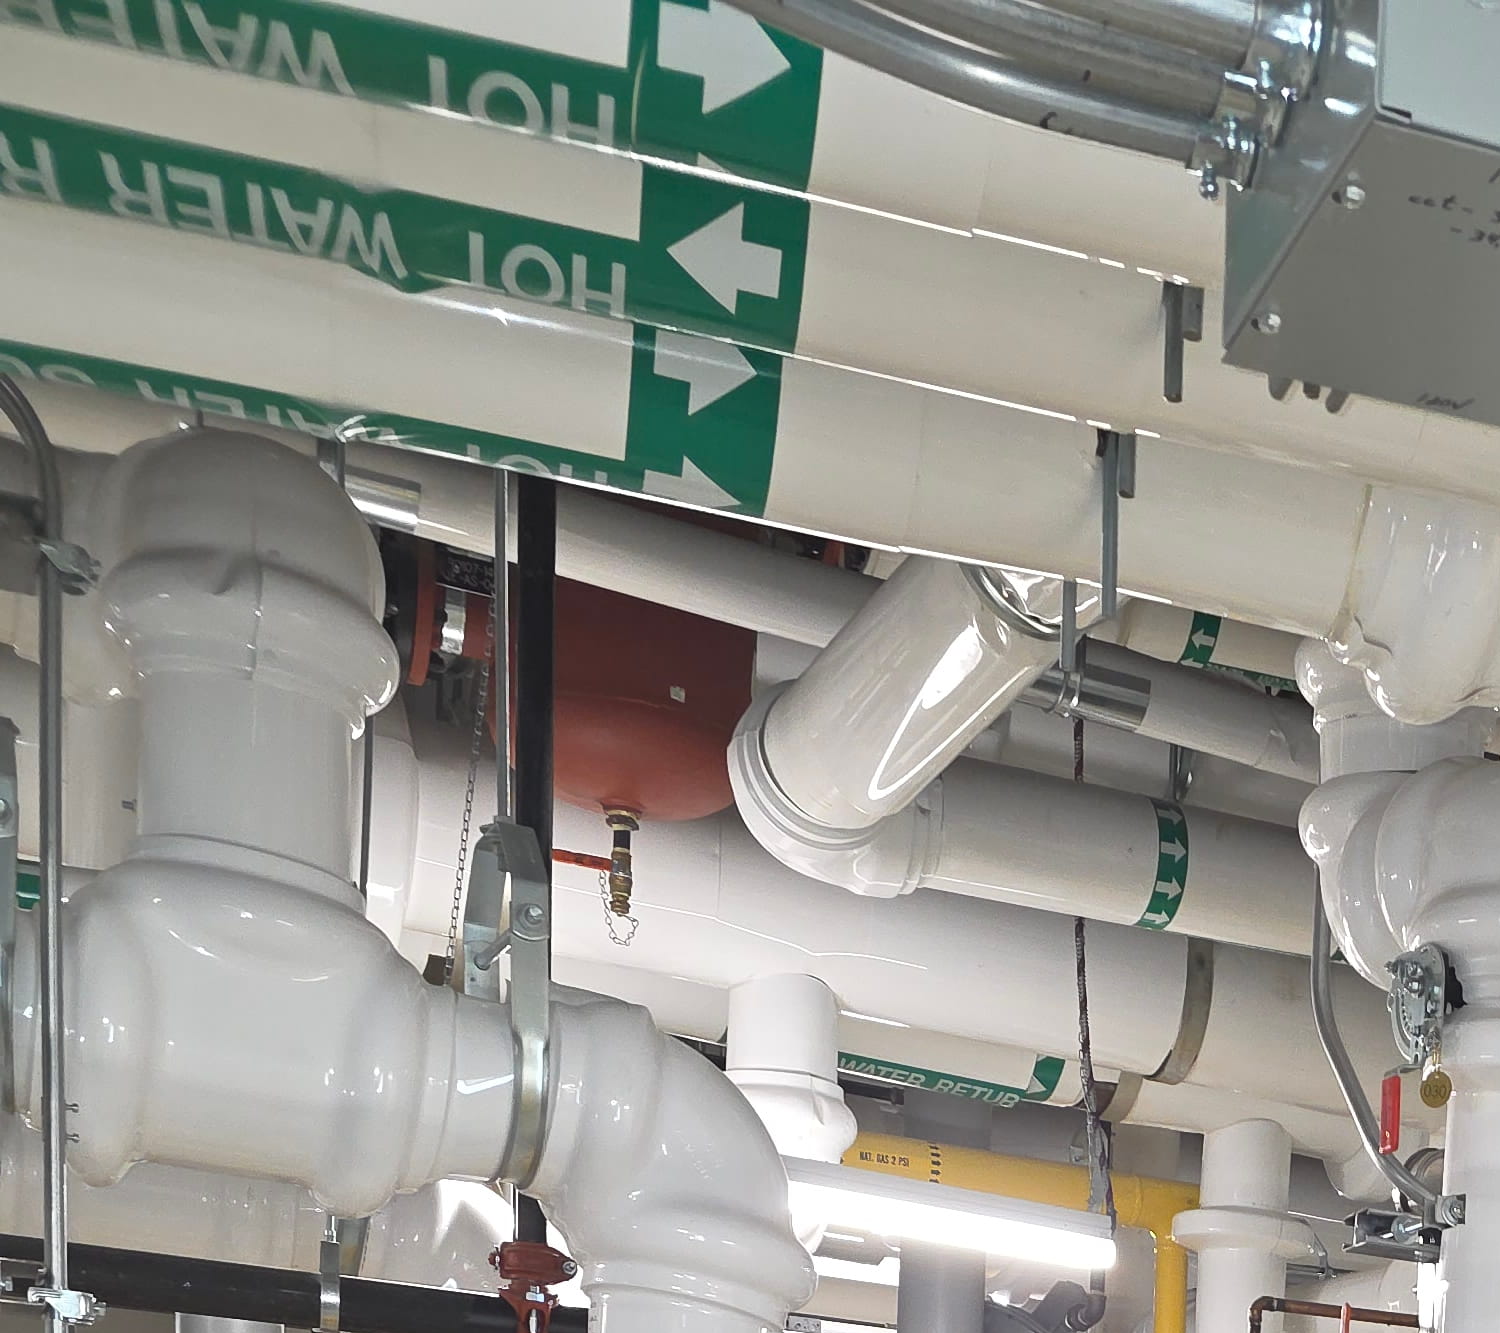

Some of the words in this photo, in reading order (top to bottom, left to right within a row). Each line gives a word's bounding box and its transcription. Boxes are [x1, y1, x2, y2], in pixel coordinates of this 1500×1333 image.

[427, 55, 618, 148] HOT
[99, 151, 409, 280] WATER
[468, 232, 626, 317] HOT
[876, 1154, 889, 1164] GAS
[891, 1155, 897, 1164] 2
[899, 1157, 909, 1167] PSI
